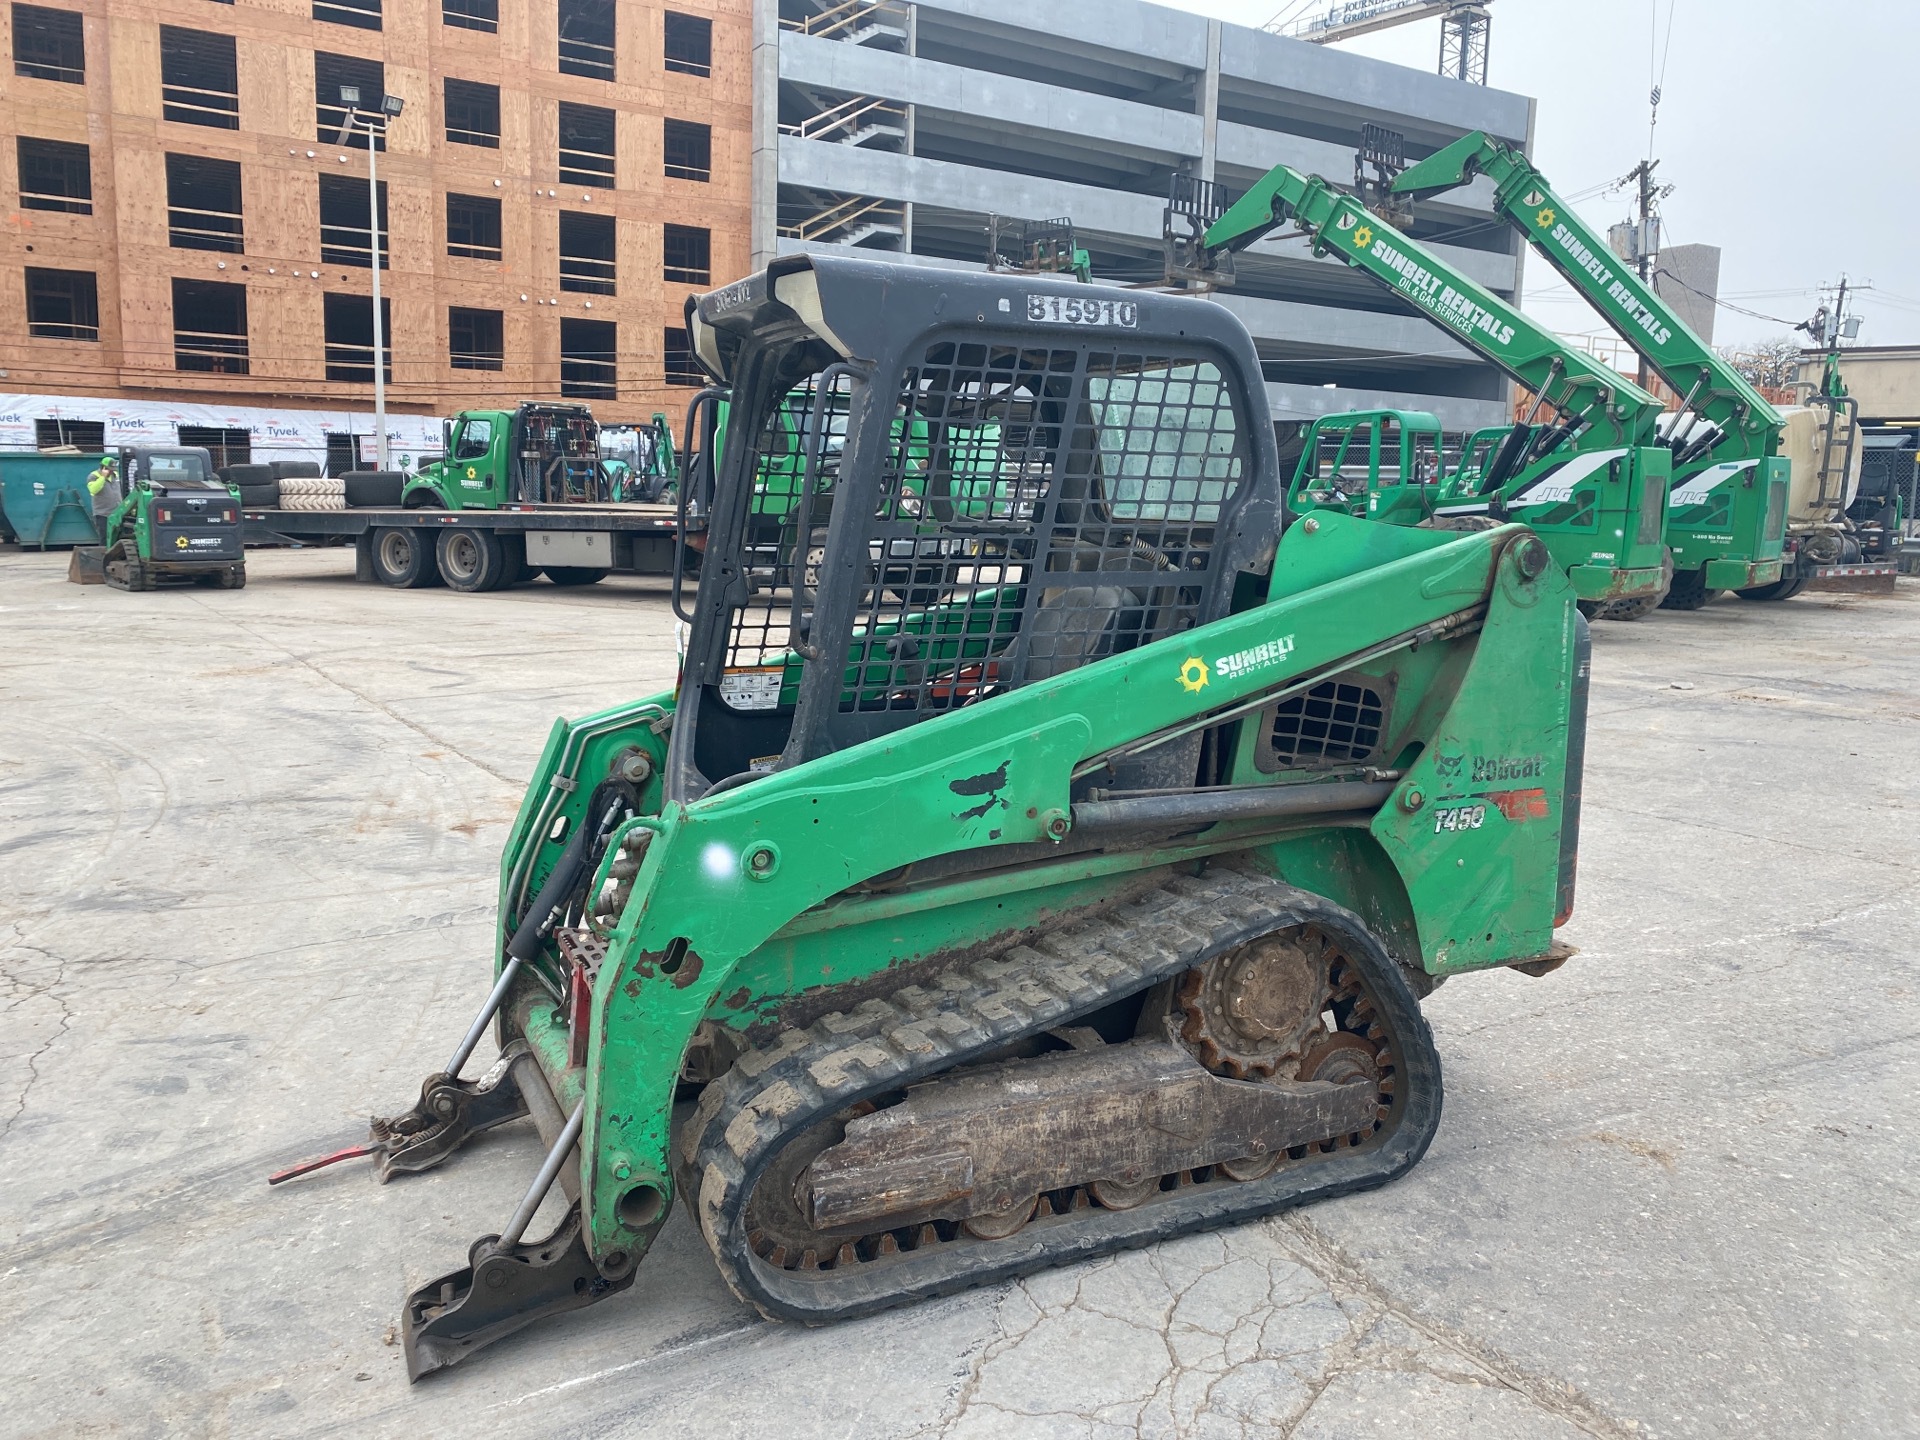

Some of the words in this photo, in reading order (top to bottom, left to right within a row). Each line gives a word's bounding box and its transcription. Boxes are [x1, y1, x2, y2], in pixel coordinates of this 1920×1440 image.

[1370, 239, 1443, 295] SUNBELT
[1438, 285, 1516, 345] RENTALS
[1551, 223, 1614, 286] SUNBELT
[1606, 279, 1672, 345] RENTALS
[1028, 294, 1137, 328] 815910
[1398, 277, 1411, 292] OIL
[1411, 286, 1419, 297] &
[1418, 290, 1437, 308] GAS
[1434, 302, 1474, 334] SERVICES
[110, 417, 145, 429] Tyvek
[267, 426, 299, 437] Tyvek
[460, 479, 484, 487] SUNBELT
[1535, 487, 1574, 503] JLG
[1673, 491, 1710, 505] JLG
[1215, 633, 1295, 676] SUNBELT
[1229, 653, 1288, 680] RENTALS
[1471, 753, 1542, 783] Bobcat
[1434, 804, 1487, 835] T450
